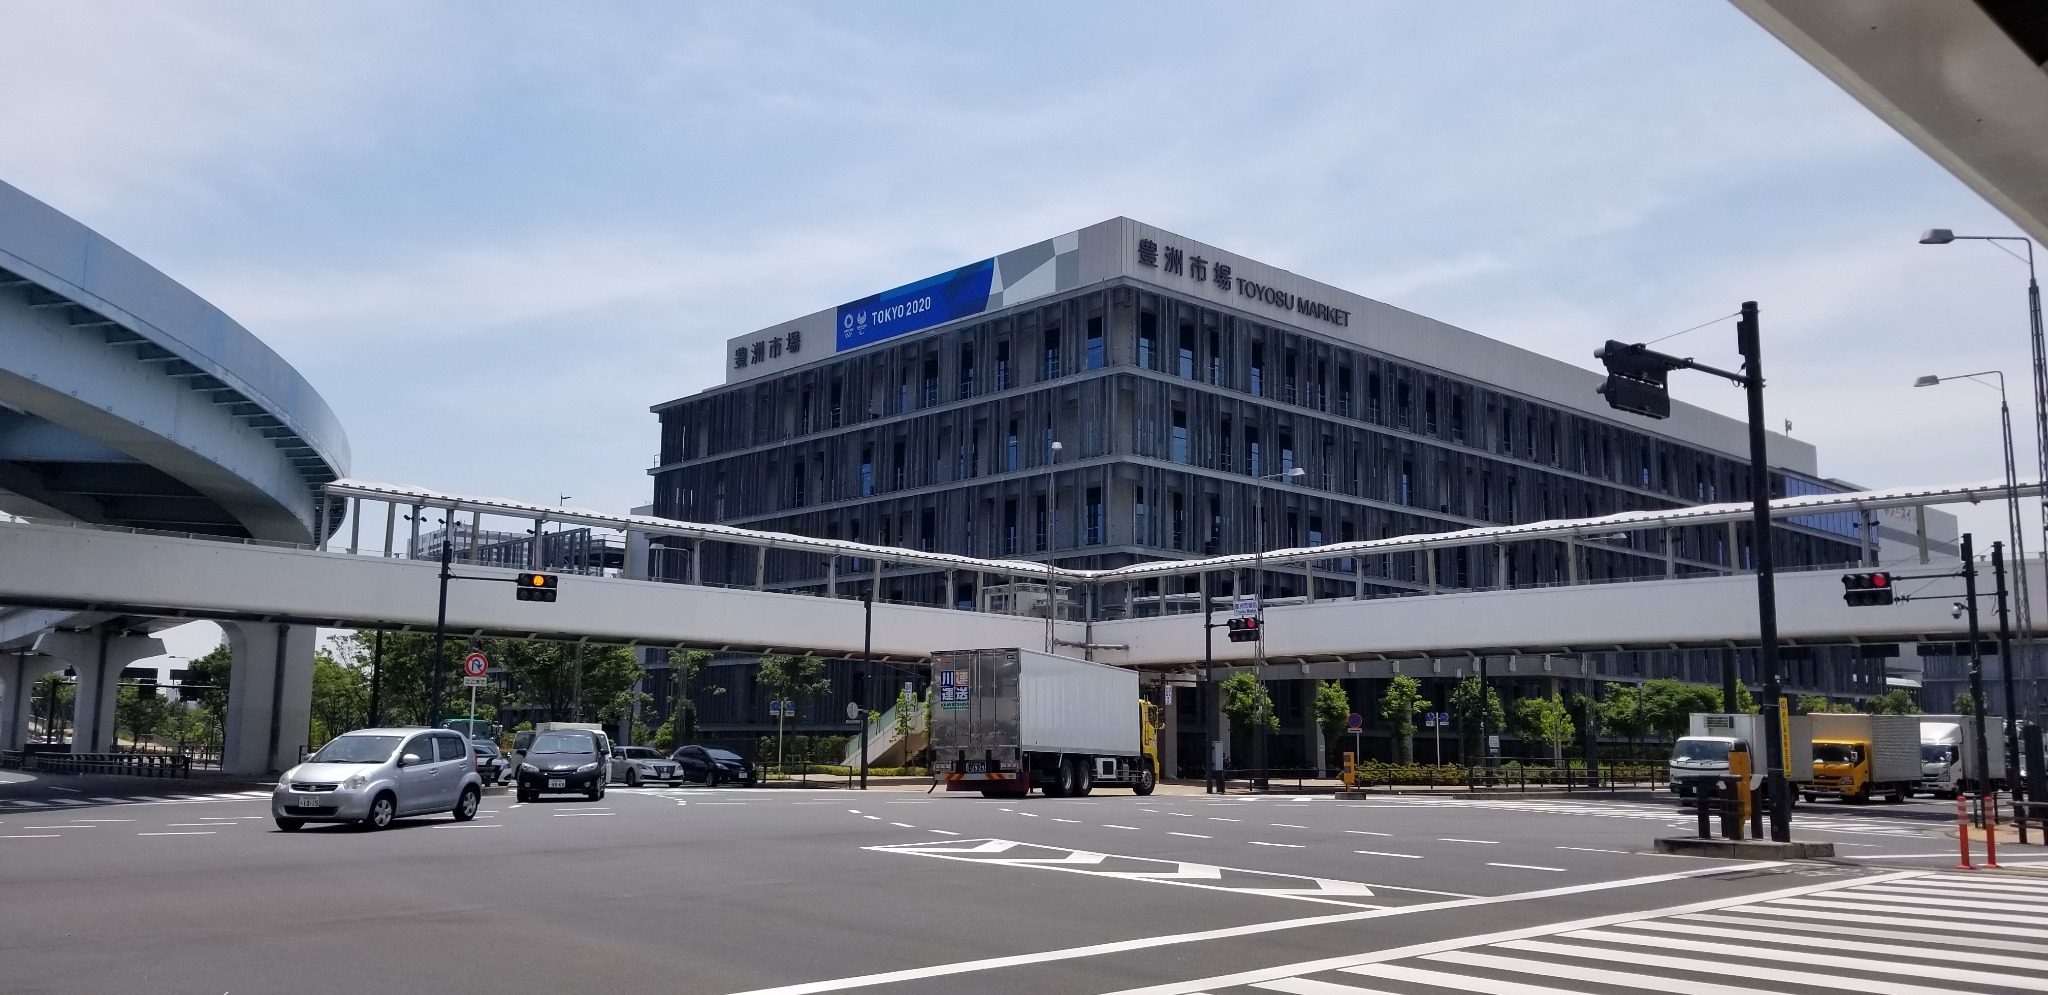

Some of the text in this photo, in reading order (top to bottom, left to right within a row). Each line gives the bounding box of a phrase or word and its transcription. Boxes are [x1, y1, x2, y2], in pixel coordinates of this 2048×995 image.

[1138, 238, 1351, 327] 豊洲市場 TOYOSU MARKET
[871, 296, 931, 326] TOKYO 2020
[734, 331, 801, 369] 豊洲市場
[942, 686, 969, 701] 運送
